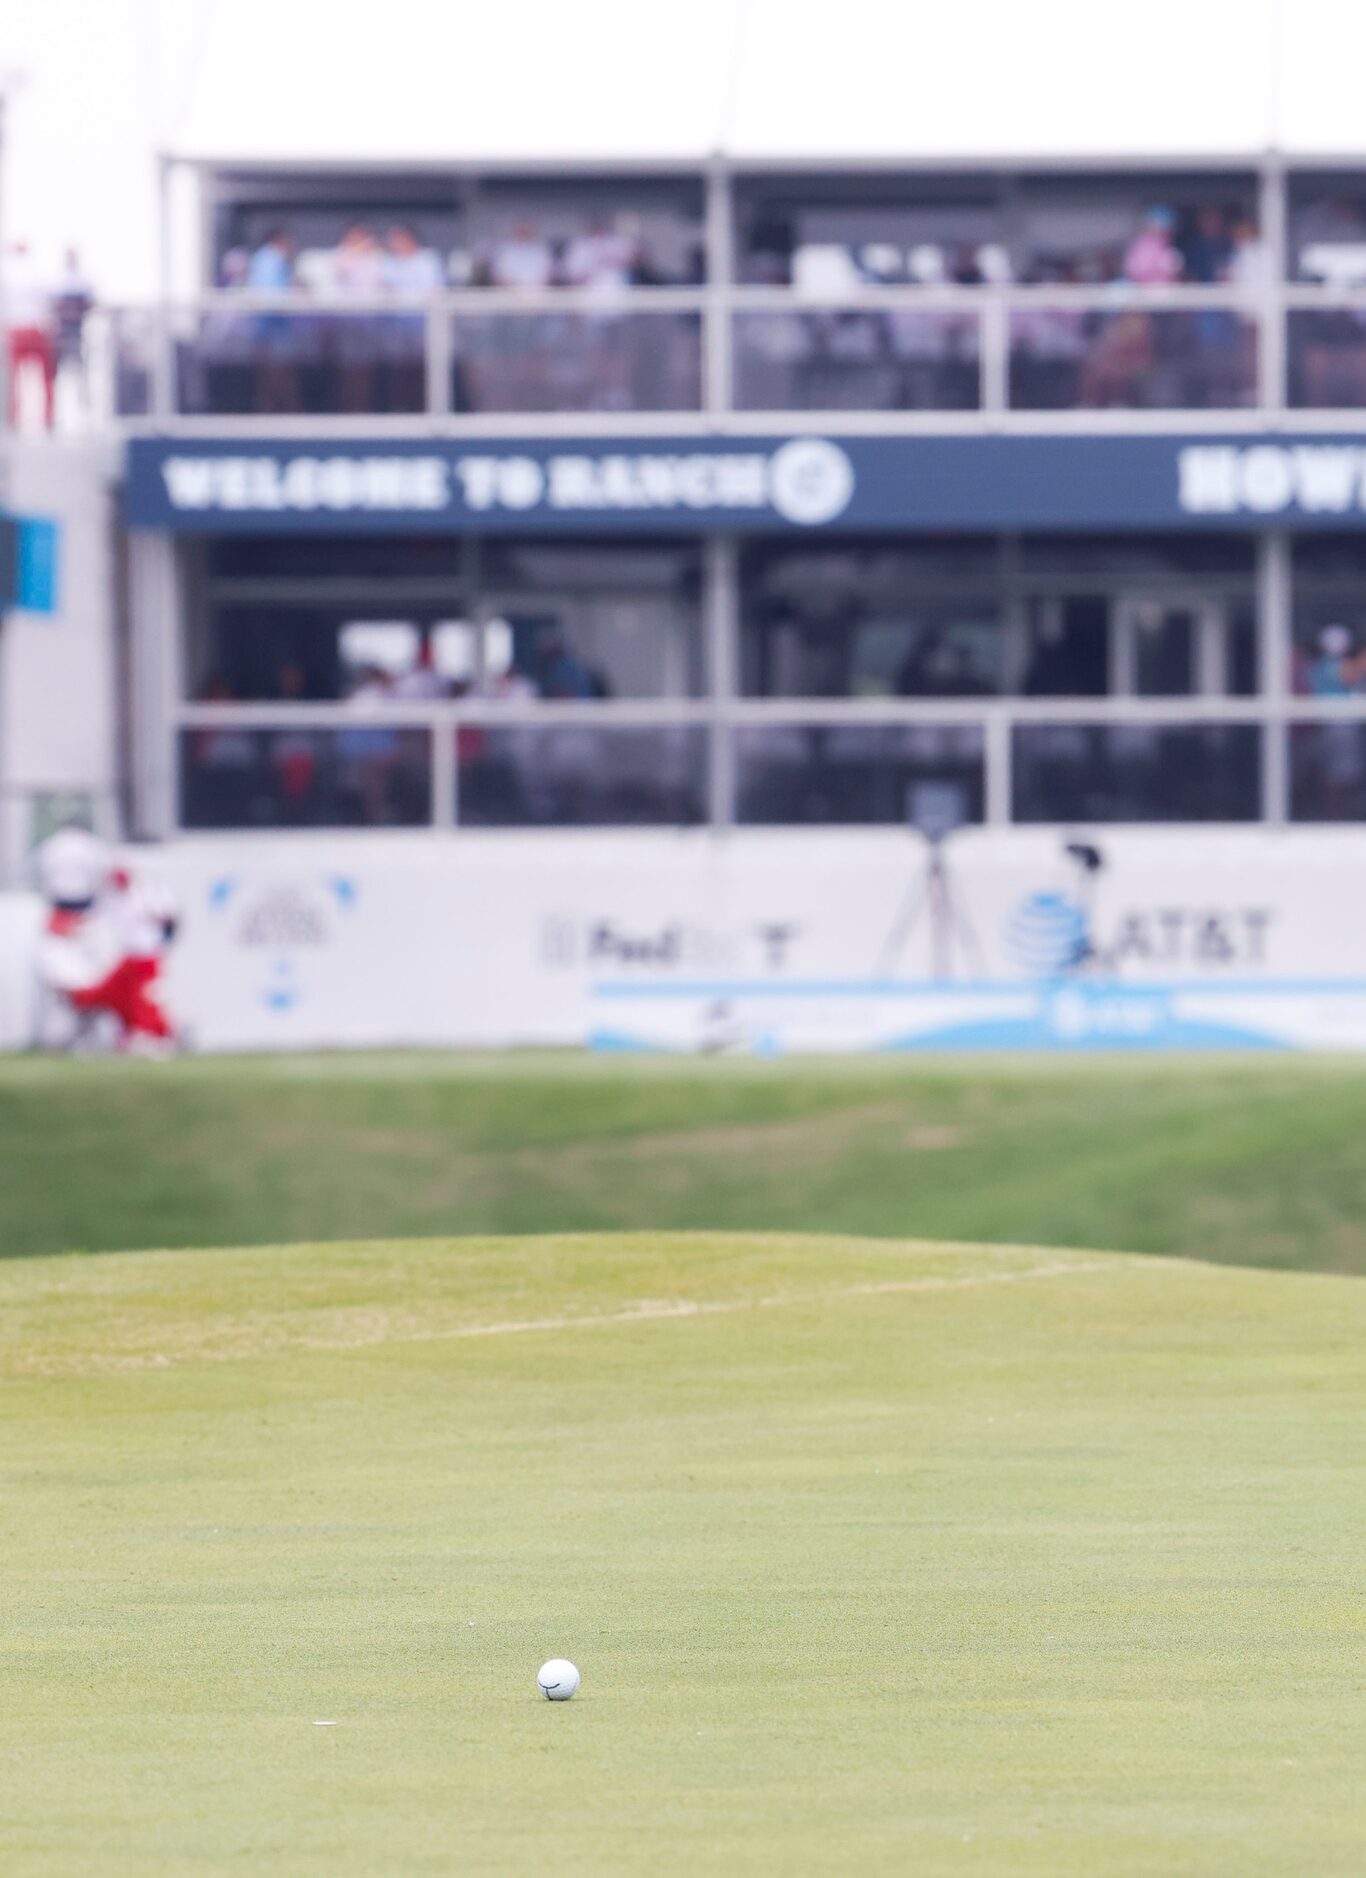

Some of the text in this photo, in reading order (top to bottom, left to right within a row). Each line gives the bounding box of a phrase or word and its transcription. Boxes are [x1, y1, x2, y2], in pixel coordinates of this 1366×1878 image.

[163, 454, 768, 510] WELCOME TO RANCH
[1115, 908, 1277, 964] AT&T
